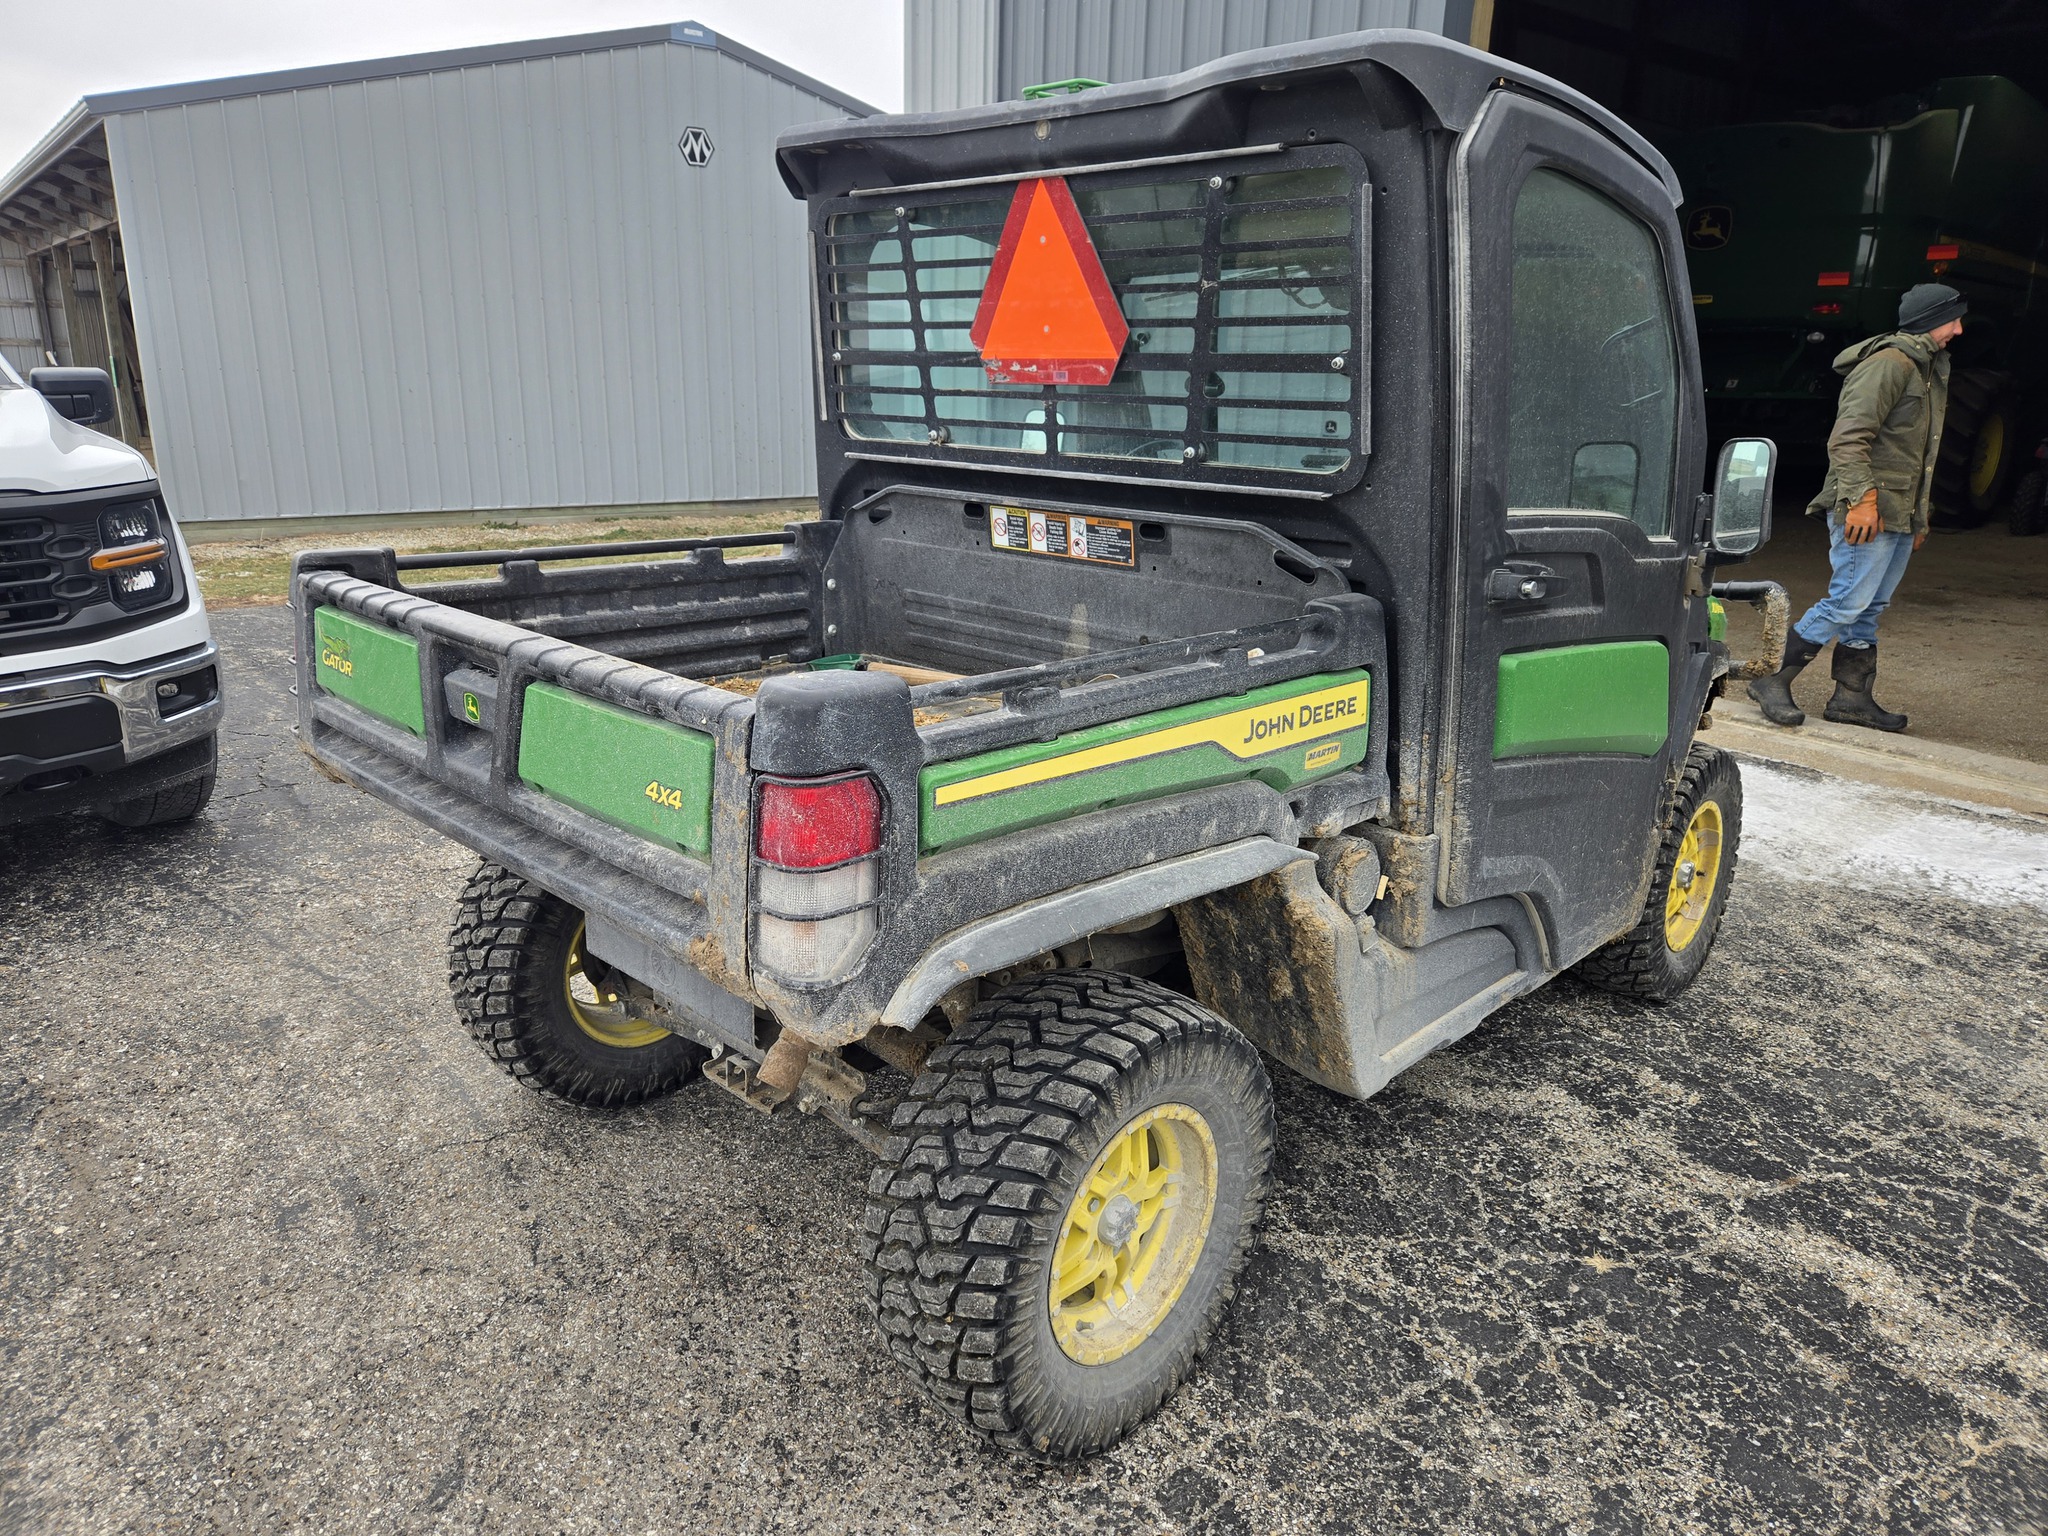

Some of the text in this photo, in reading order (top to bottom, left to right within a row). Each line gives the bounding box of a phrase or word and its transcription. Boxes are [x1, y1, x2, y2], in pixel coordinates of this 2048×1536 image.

[321, 648, 353, 677] GATOR
[1243, 696, 1358, 744] JOHN DEERE
[1308, 744, 1341, 761] MARTIN
